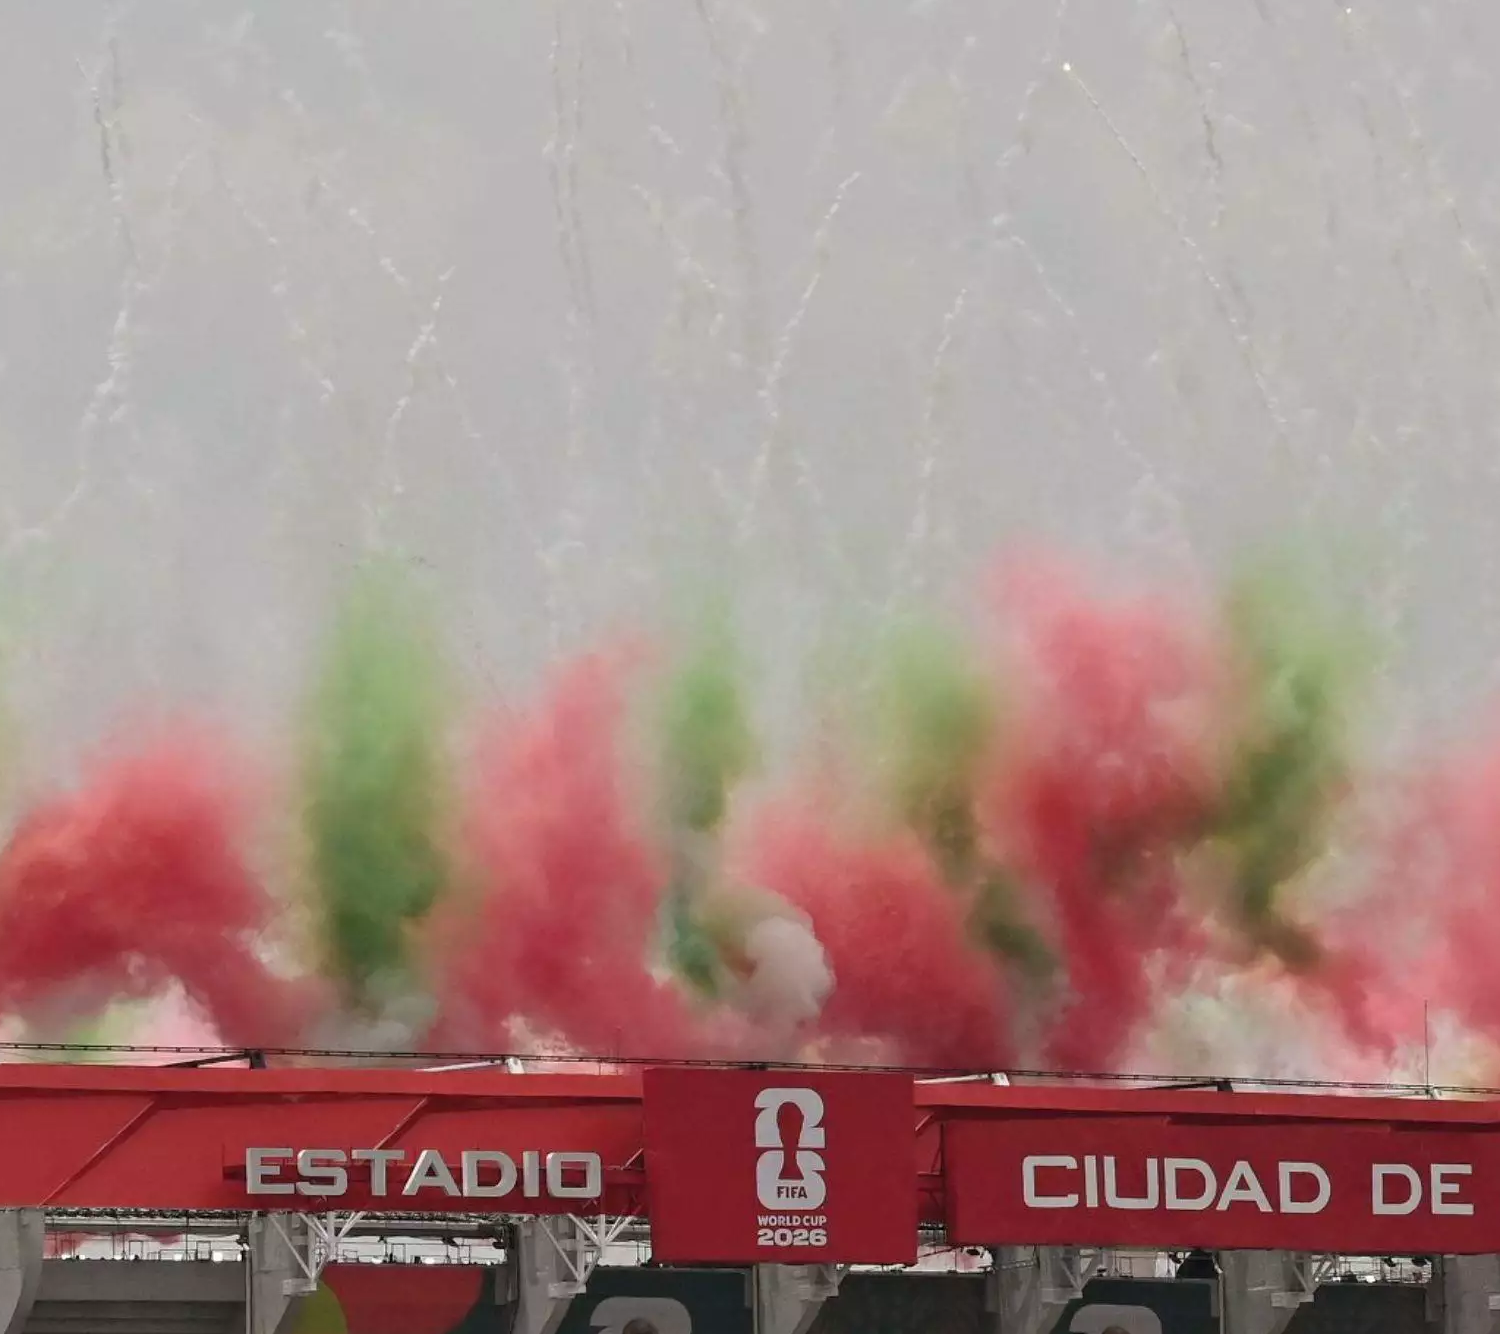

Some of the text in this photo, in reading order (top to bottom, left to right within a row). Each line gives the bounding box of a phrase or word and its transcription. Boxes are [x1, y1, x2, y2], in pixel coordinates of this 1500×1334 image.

[245, 1148, 602, 1200] ESTADIO
[776, 1185, 808, 1199] FIFA
[1022, 1155, 1331, 1213] CIUDAD
[1372, 1164, 1475, 1216] DE
[757, 1215, 827, 1227] WORLD CUP
[757, 1228, 828, 1247] 2026
